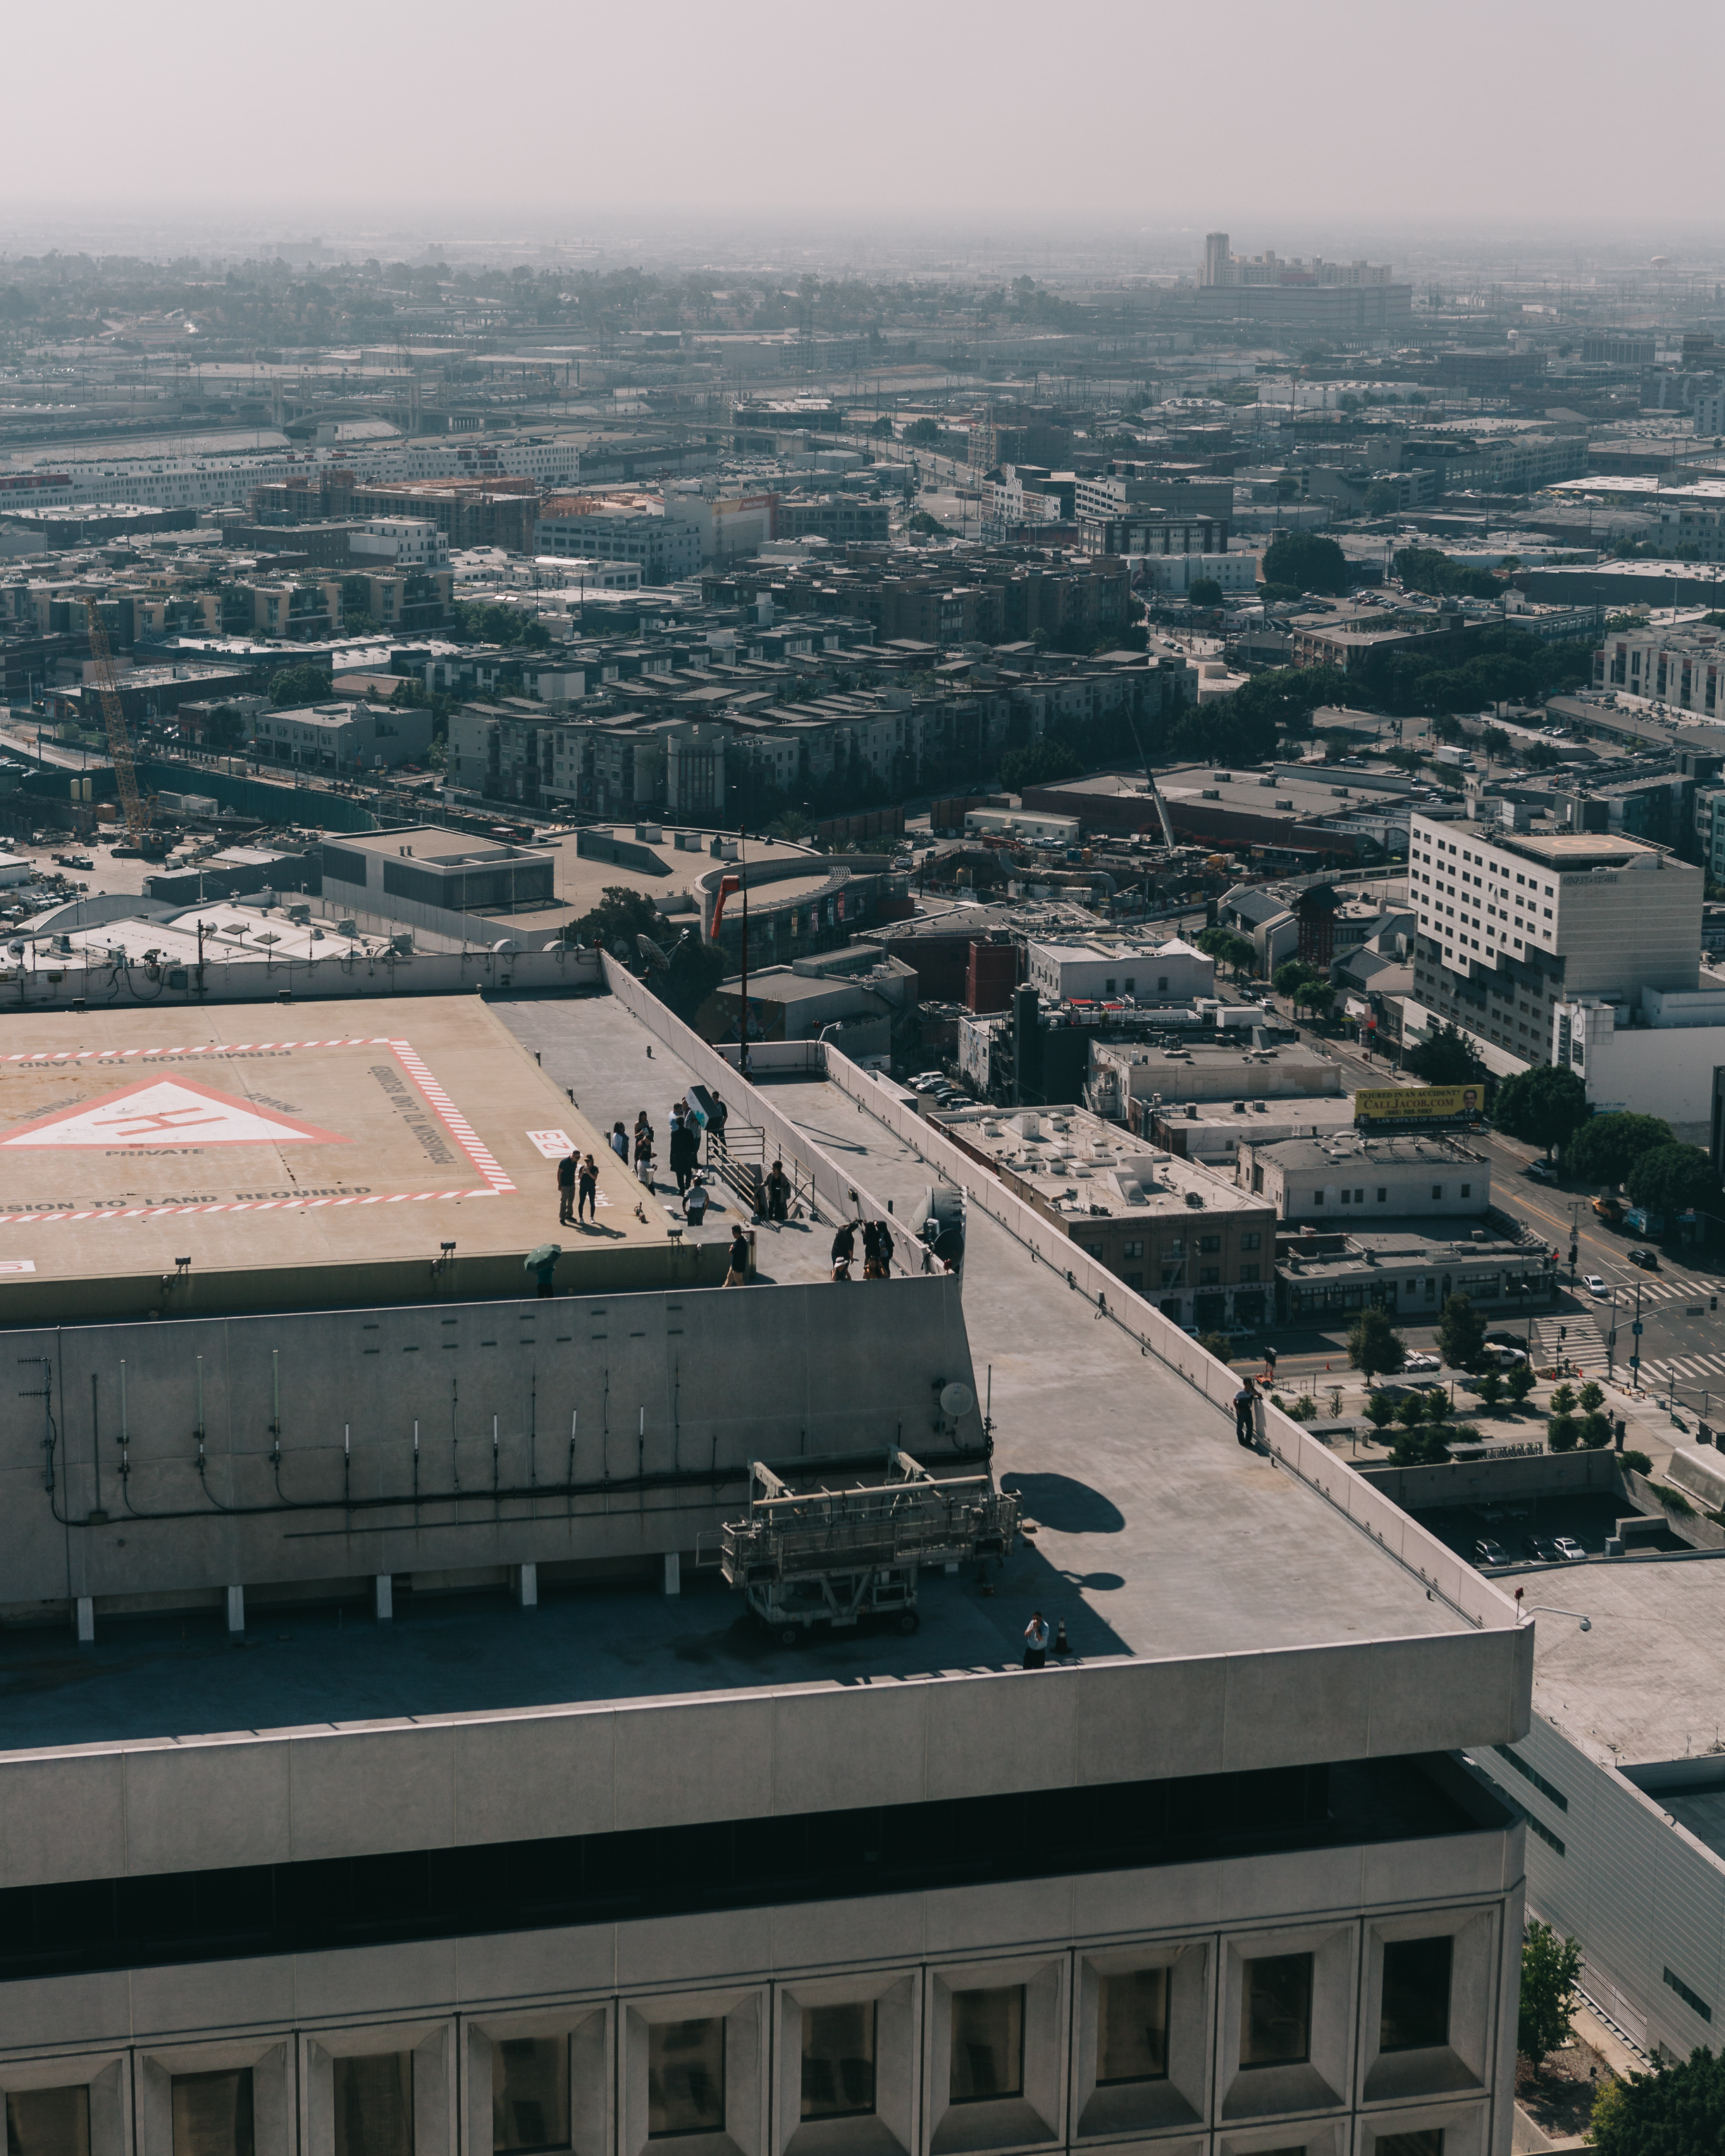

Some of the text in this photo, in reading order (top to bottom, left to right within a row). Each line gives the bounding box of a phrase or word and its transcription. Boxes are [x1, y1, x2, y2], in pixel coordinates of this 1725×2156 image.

[1563, 875, 1618, 884] MIYAKO HOTEL
[142, 1051, 292, 1062] PERMISSION
[17, 1098, 81, 1119] PRIVATE
[243, 1093, 303, 1113] PRIVATE
[370, 1065, 457, 1164] PERMISSION TO LAND REQUIRED
[145, 1196, 218, 1205] LAND
[235, 1187, 372, 1200] REQUIRED
